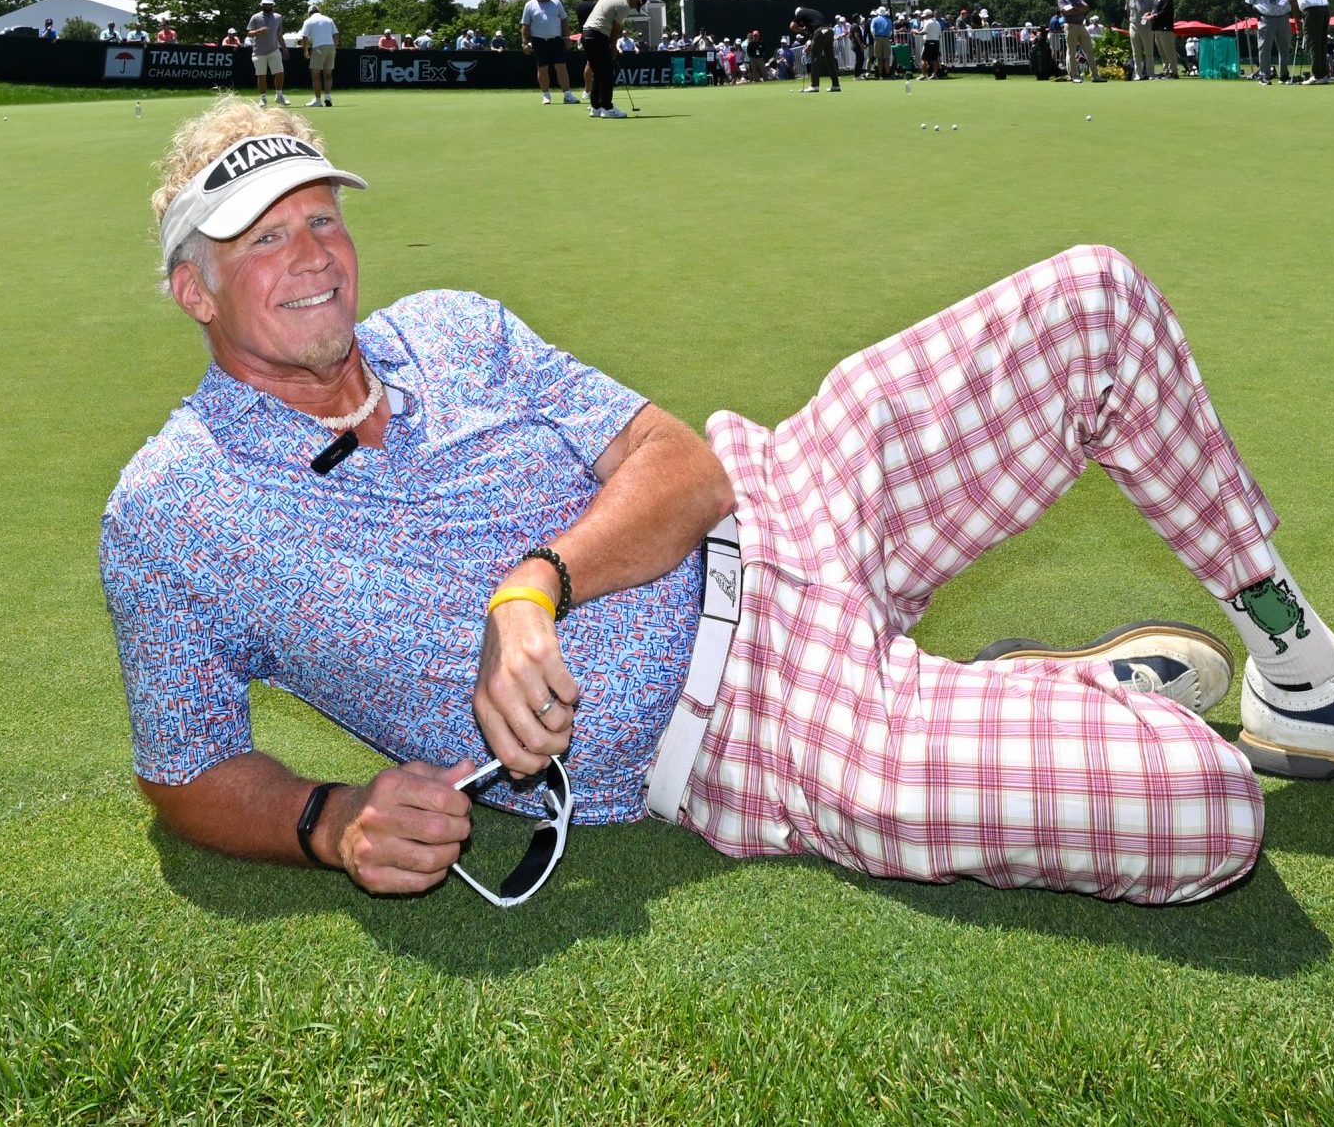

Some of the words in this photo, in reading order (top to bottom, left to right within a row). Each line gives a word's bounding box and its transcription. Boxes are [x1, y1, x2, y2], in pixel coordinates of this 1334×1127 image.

[149, 50, 233, 67] TRAVELERS
[148, 68, 233, 80] CHAMPIONSHIP
[380, 59, 448, 83] FedEx
[612, 67, 693, 85] AVELES
[222, 137, 306, 179] HAWK
